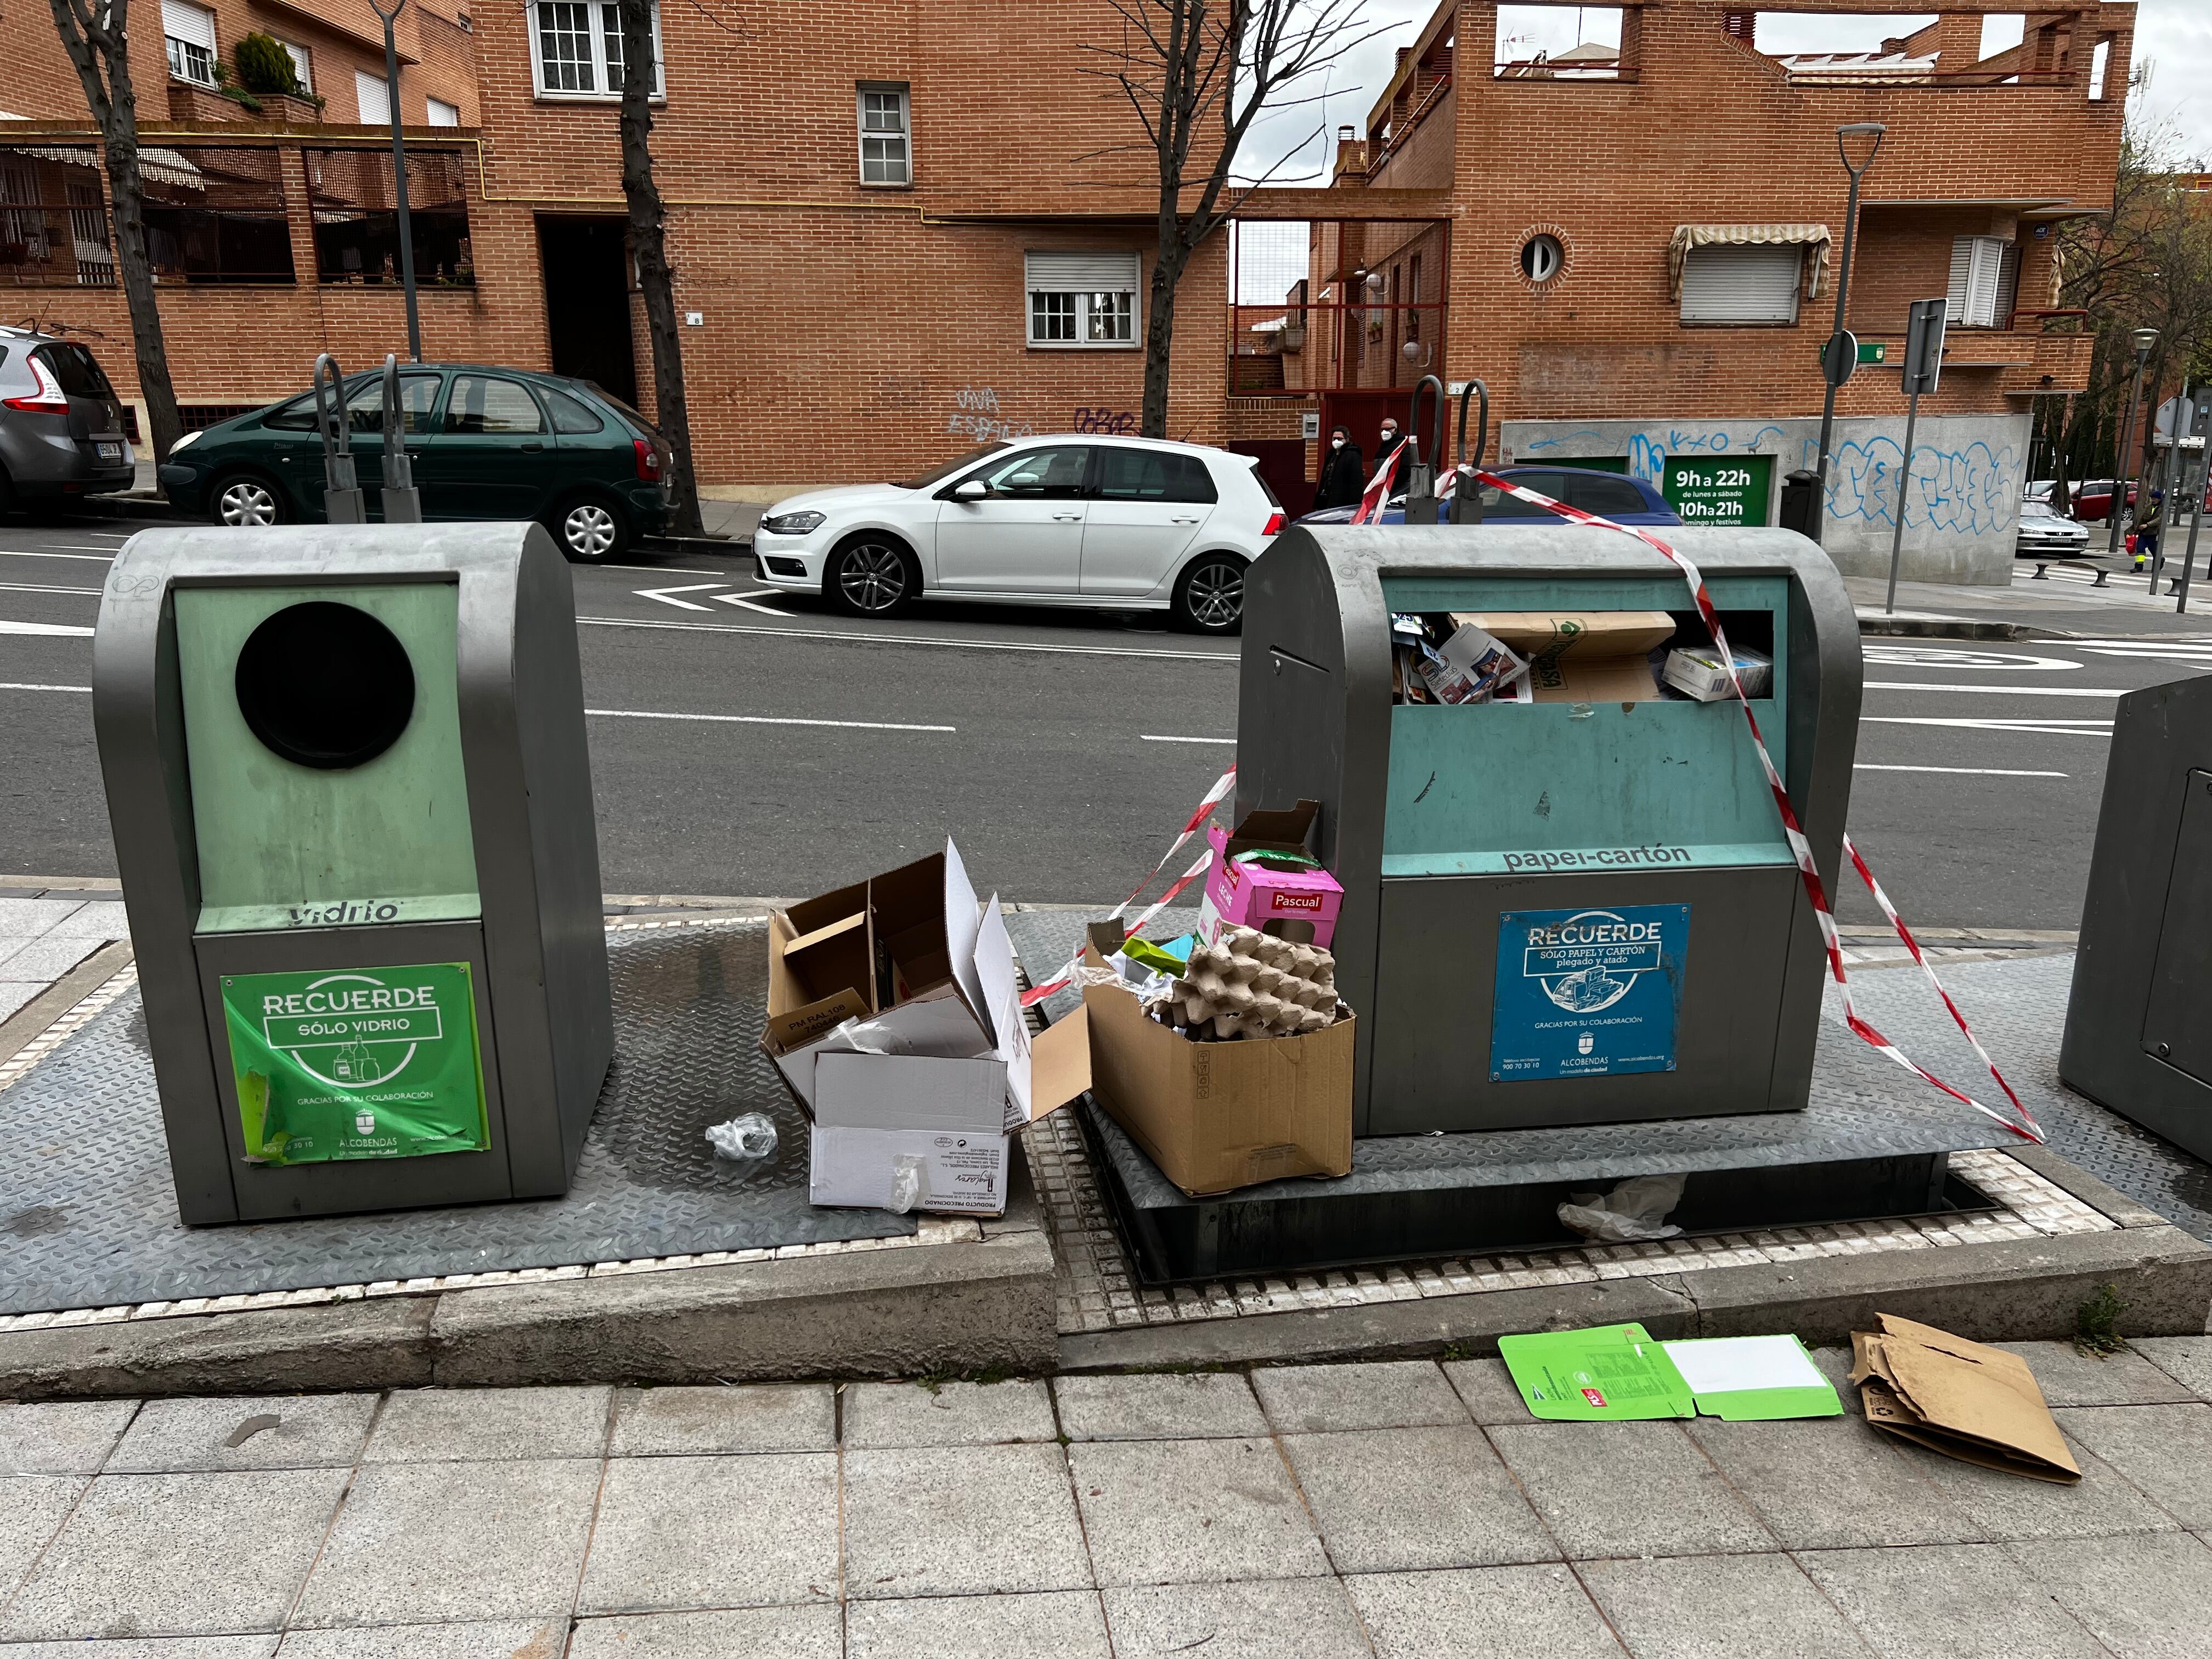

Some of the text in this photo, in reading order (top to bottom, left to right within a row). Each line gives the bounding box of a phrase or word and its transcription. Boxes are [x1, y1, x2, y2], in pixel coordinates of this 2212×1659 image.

[1676, 470, 1750, 487] 9h a 22h
[1679, 501, 1743, 516] 10h a 21h
[1218, 882, 1233, 907] LECHE
[1276, 895, 1319, 907] Pascual
[290, 900, 398, 924] vidrio
[1528, 922, 1662, 945] RECUERDE
[1540, 949, 1566, 959] SÓLO
[1568, 949, 1596, 957] PAPEL
[1606, 945, 1646, 956] CARTÓN
[1556, 958, 1593, 968] plegado
[1603, 956, 1628, 964] atado
[263, 986, 436, 1014] RECUERDE
[298, 1018, 410, 1036] SÓLO VIDRIO
[788, 1019, 806, 1031] PM
[1589, 1016, 1643, 1025] COLABORACIÓN
[1560, 1057, 1609, 1066] ALCOBENDAS
[297, 1097, 332, 1105] GRACIAS
[365, 1092, 433, 1102] COLABORACIÓN
[339, 1138, 397, 1148] ALCOBENDAS
